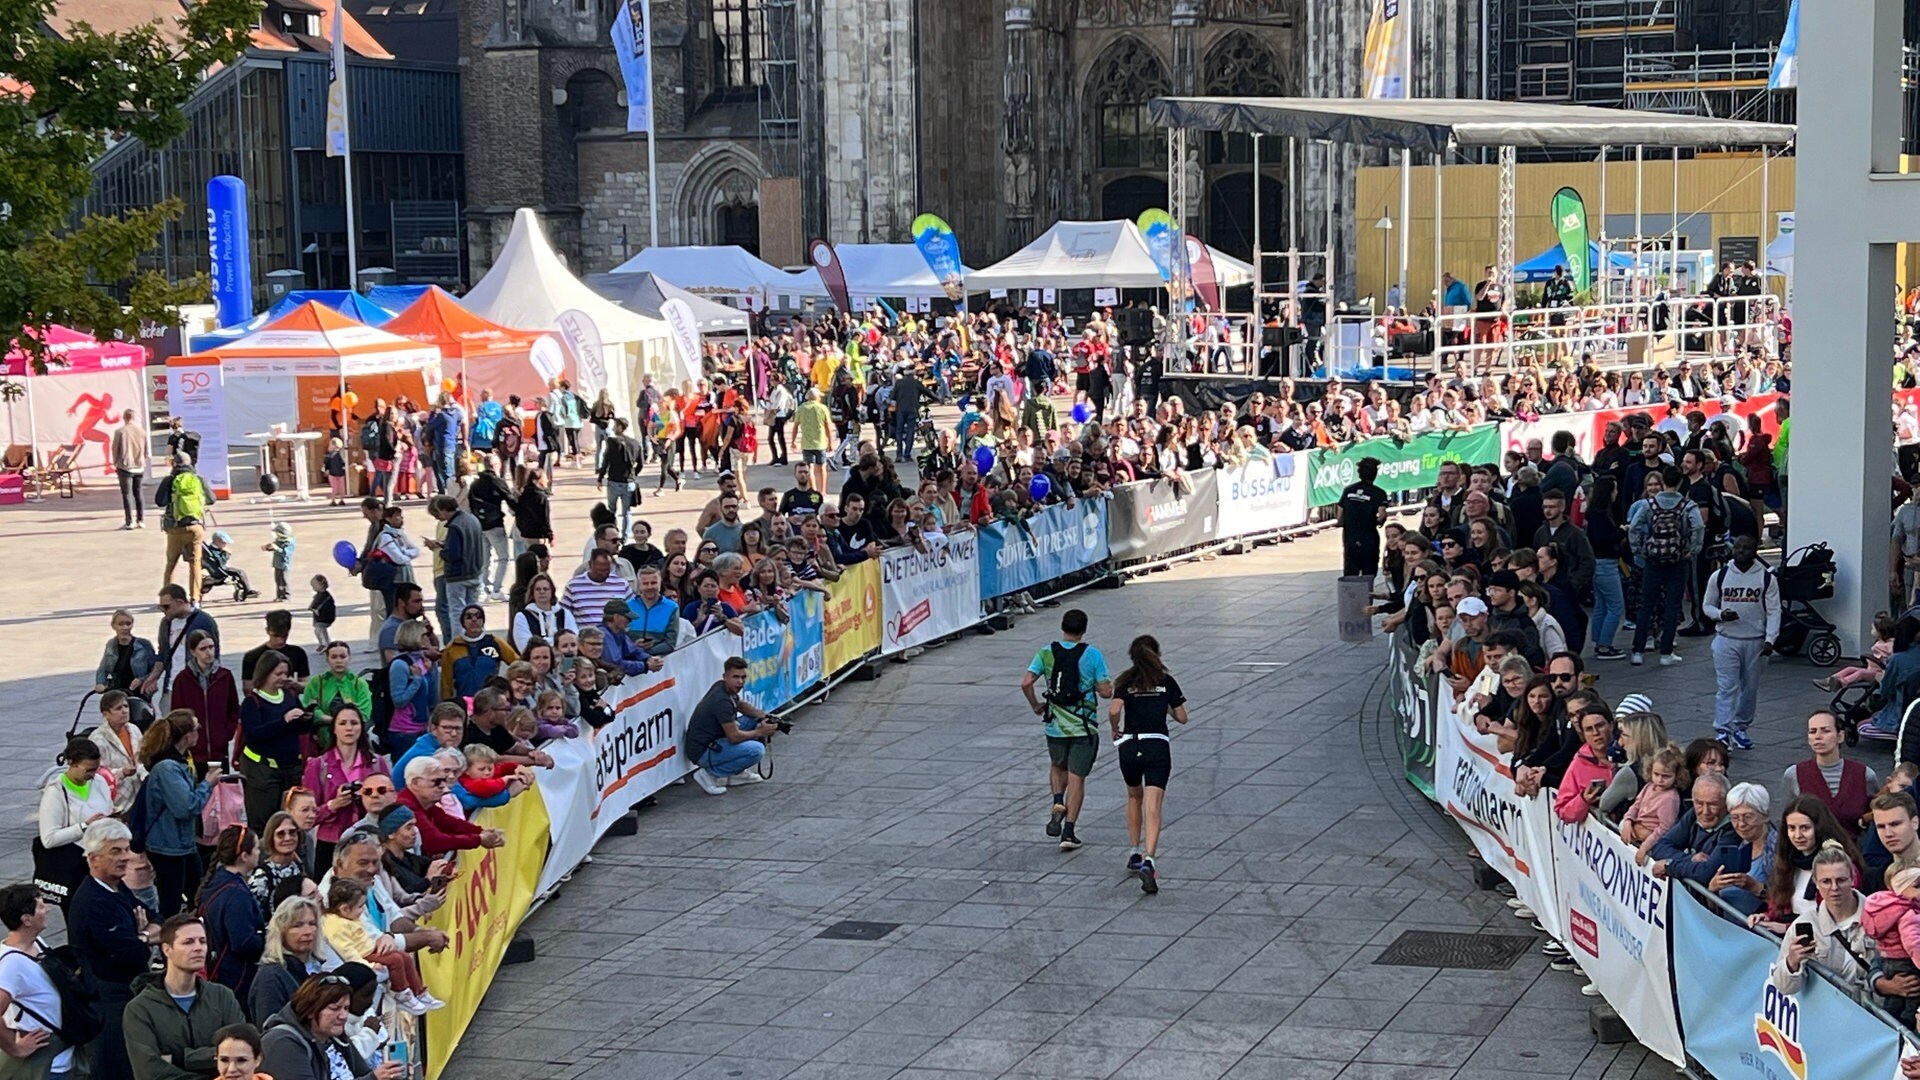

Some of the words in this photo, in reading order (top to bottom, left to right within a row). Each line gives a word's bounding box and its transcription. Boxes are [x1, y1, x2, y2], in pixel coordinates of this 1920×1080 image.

[221, 209, 233, 261] Productivity
[224, 262, 234, 293] Proven
[1313, 464, 1341, 490] AOK
[1422, 453, 1437, 469] für
[1043, 526, 1078, 555] PRESSE
[1746, 587, 1760, 598] DO
[743, 620, 776, 652] Bade
